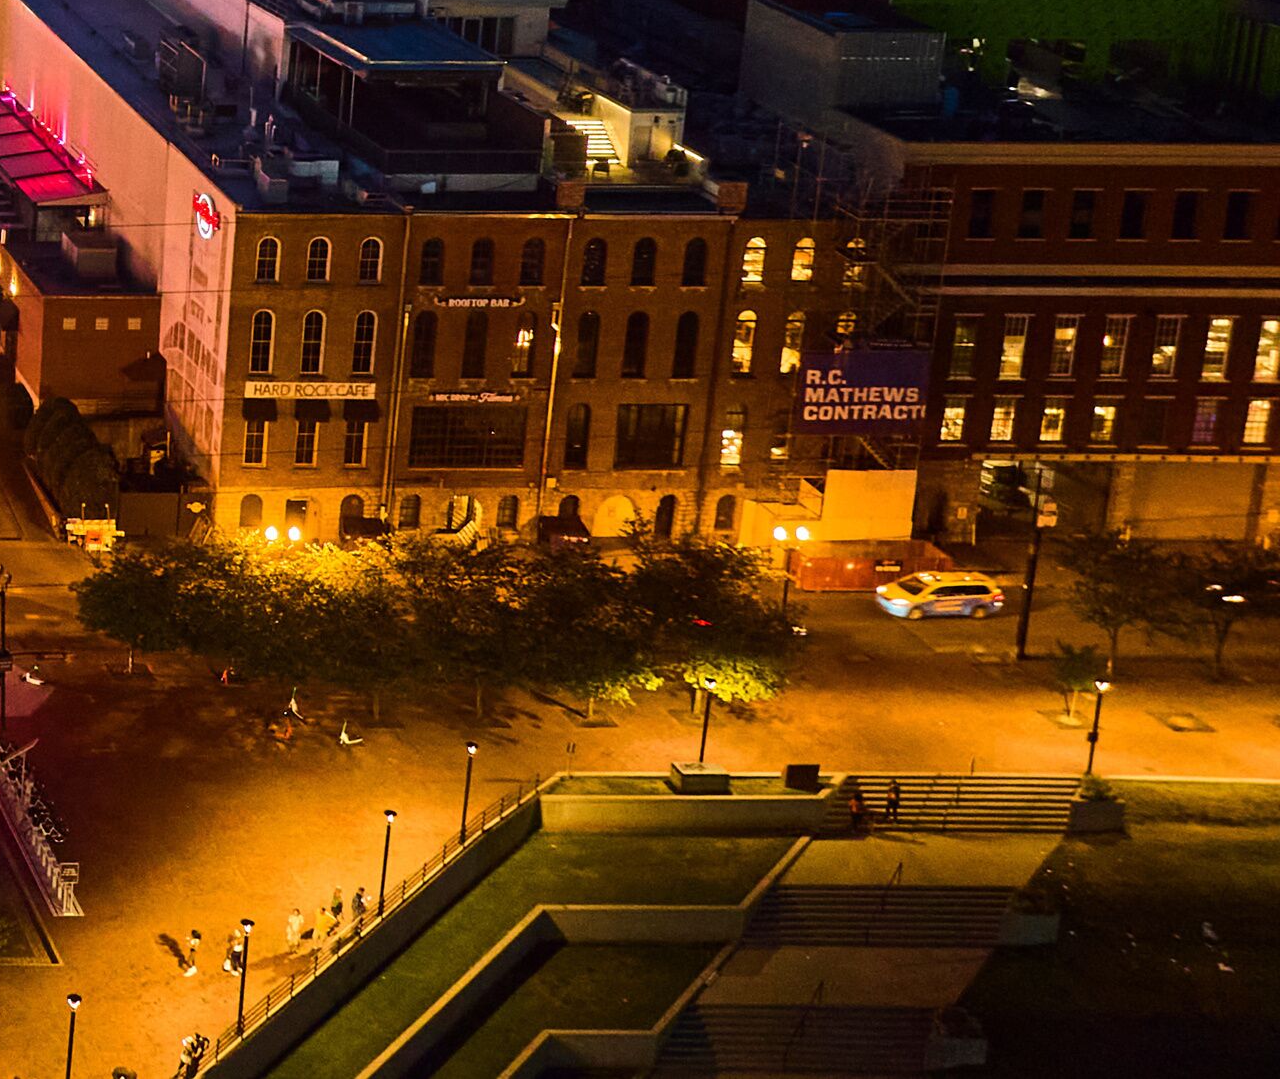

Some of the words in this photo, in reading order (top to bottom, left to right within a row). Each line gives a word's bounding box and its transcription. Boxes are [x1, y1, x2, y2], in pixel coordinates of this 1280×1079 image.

[448, 298, 489, 307] ROOFTOP
[490, 298, 510, 307] BAR
[806, 369, 847, 385] R.C.
[253, 384, 291, 396] HARD
[294, 384, 334, 397] ROCK
[335, 384, 369, 397] CAFE
[805, 386, 920, 403] MATHEWS
